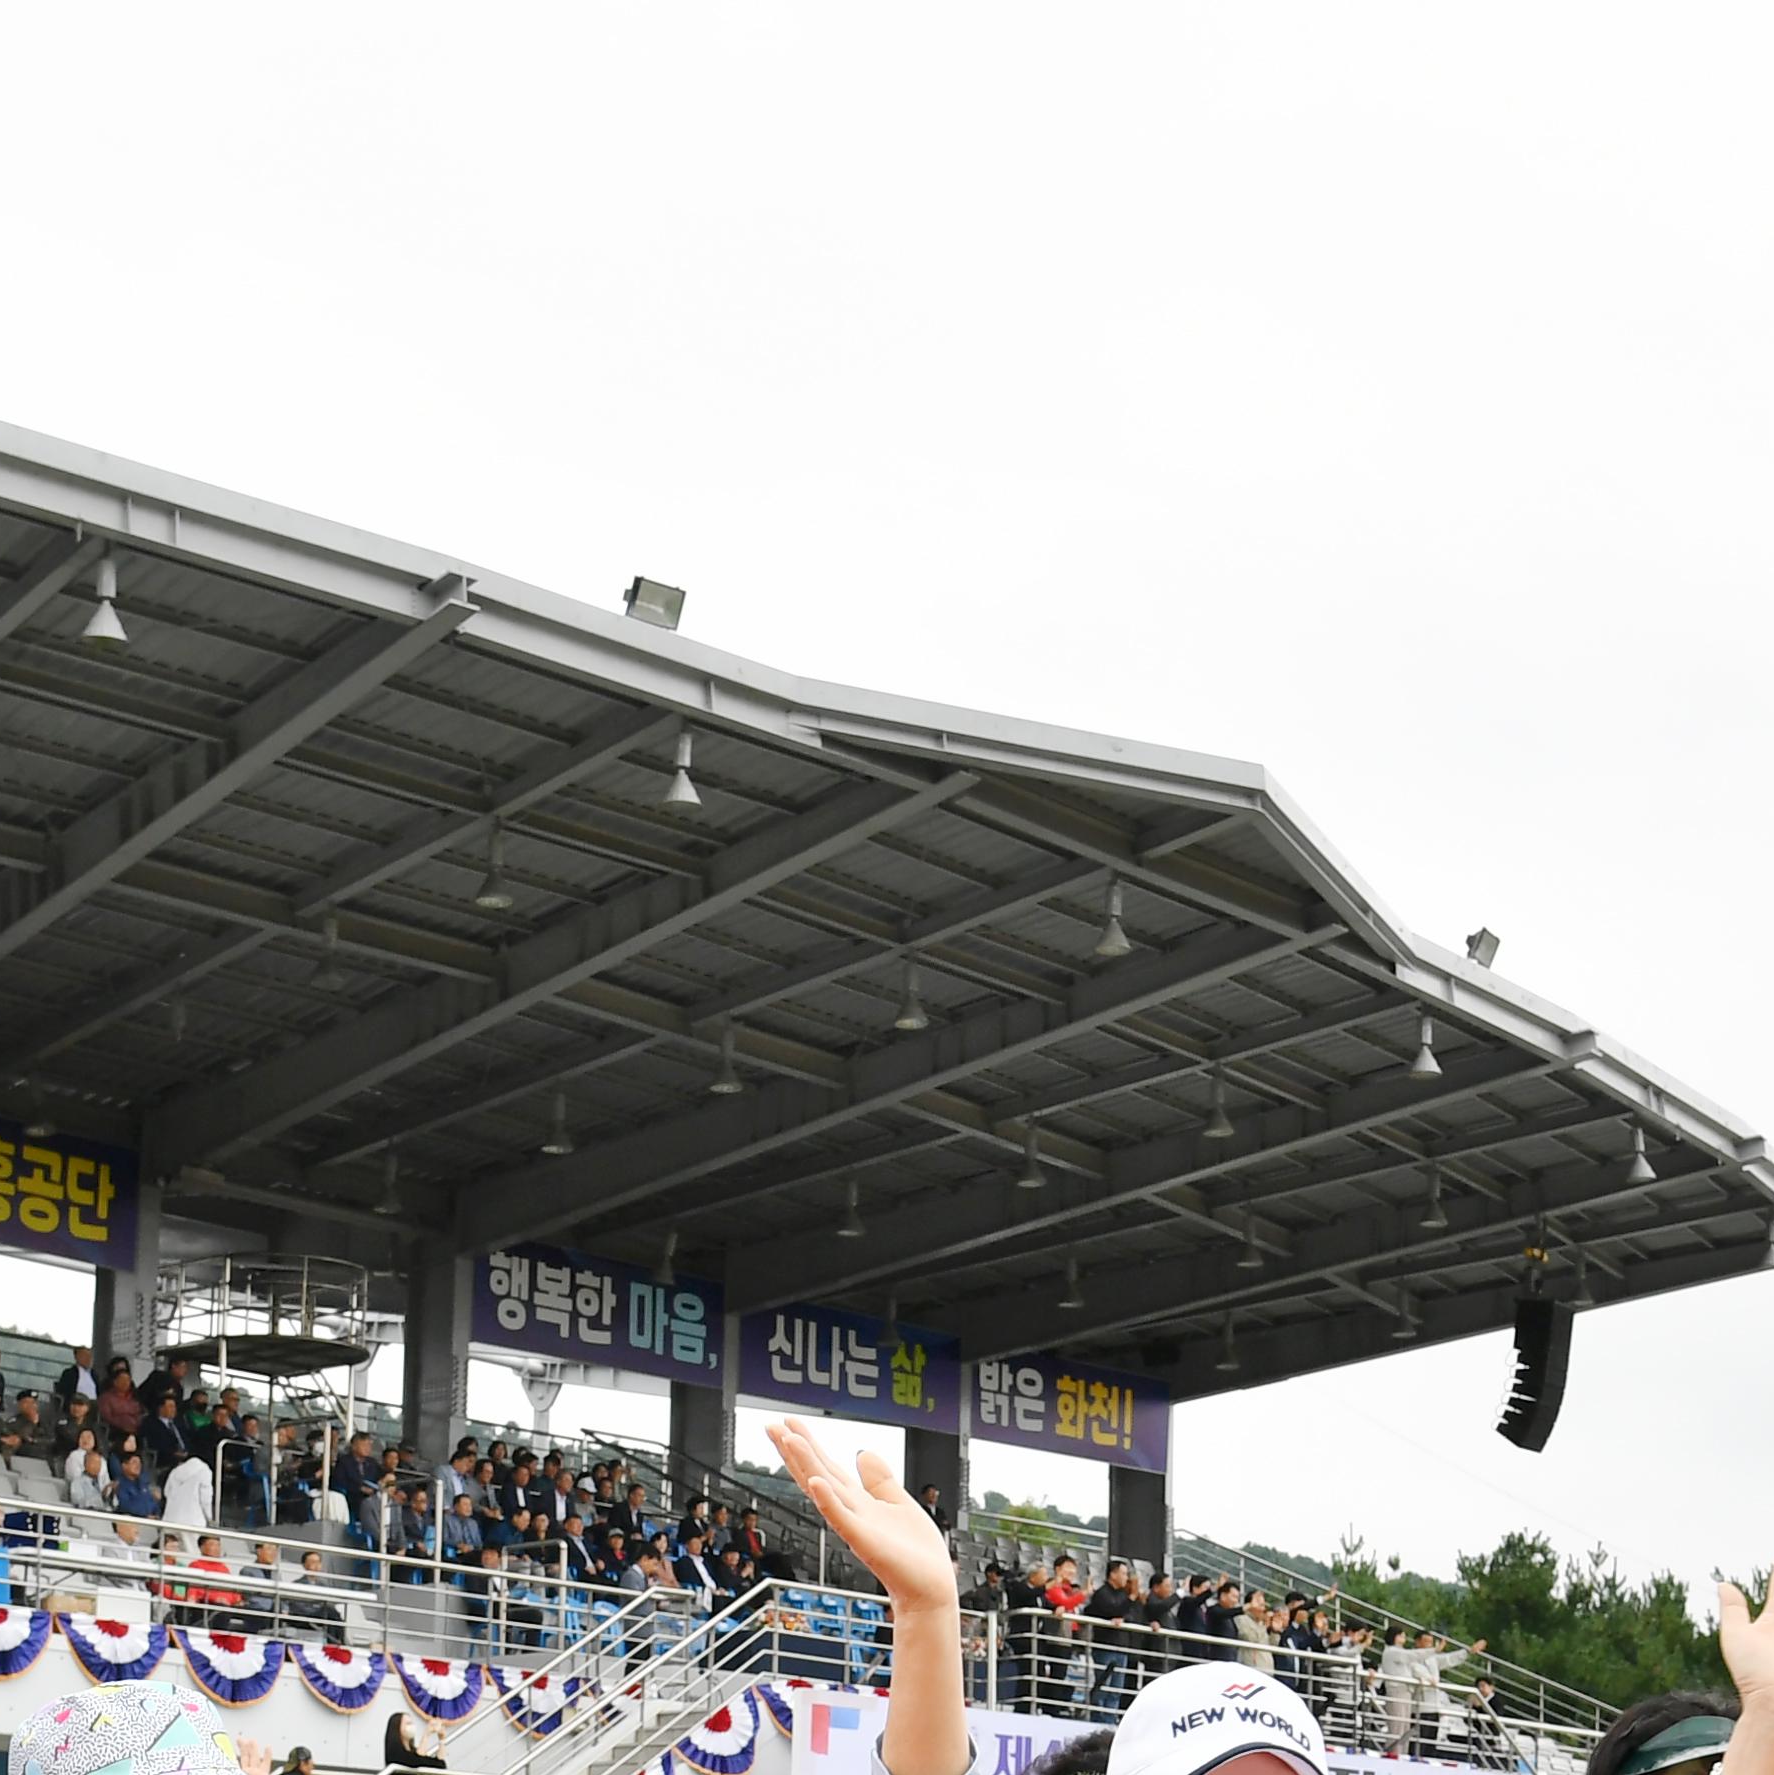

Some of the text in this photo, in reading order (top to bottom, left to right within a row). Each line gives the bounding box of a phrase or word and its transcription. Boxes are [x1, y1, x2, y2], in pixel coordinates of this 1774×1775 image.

[489, 1251, 1135, 1451] 행복한 마음, 신나는 삶, 밝은 화천!
[1171, 1706, 1312, 1752] NEW WORLD
